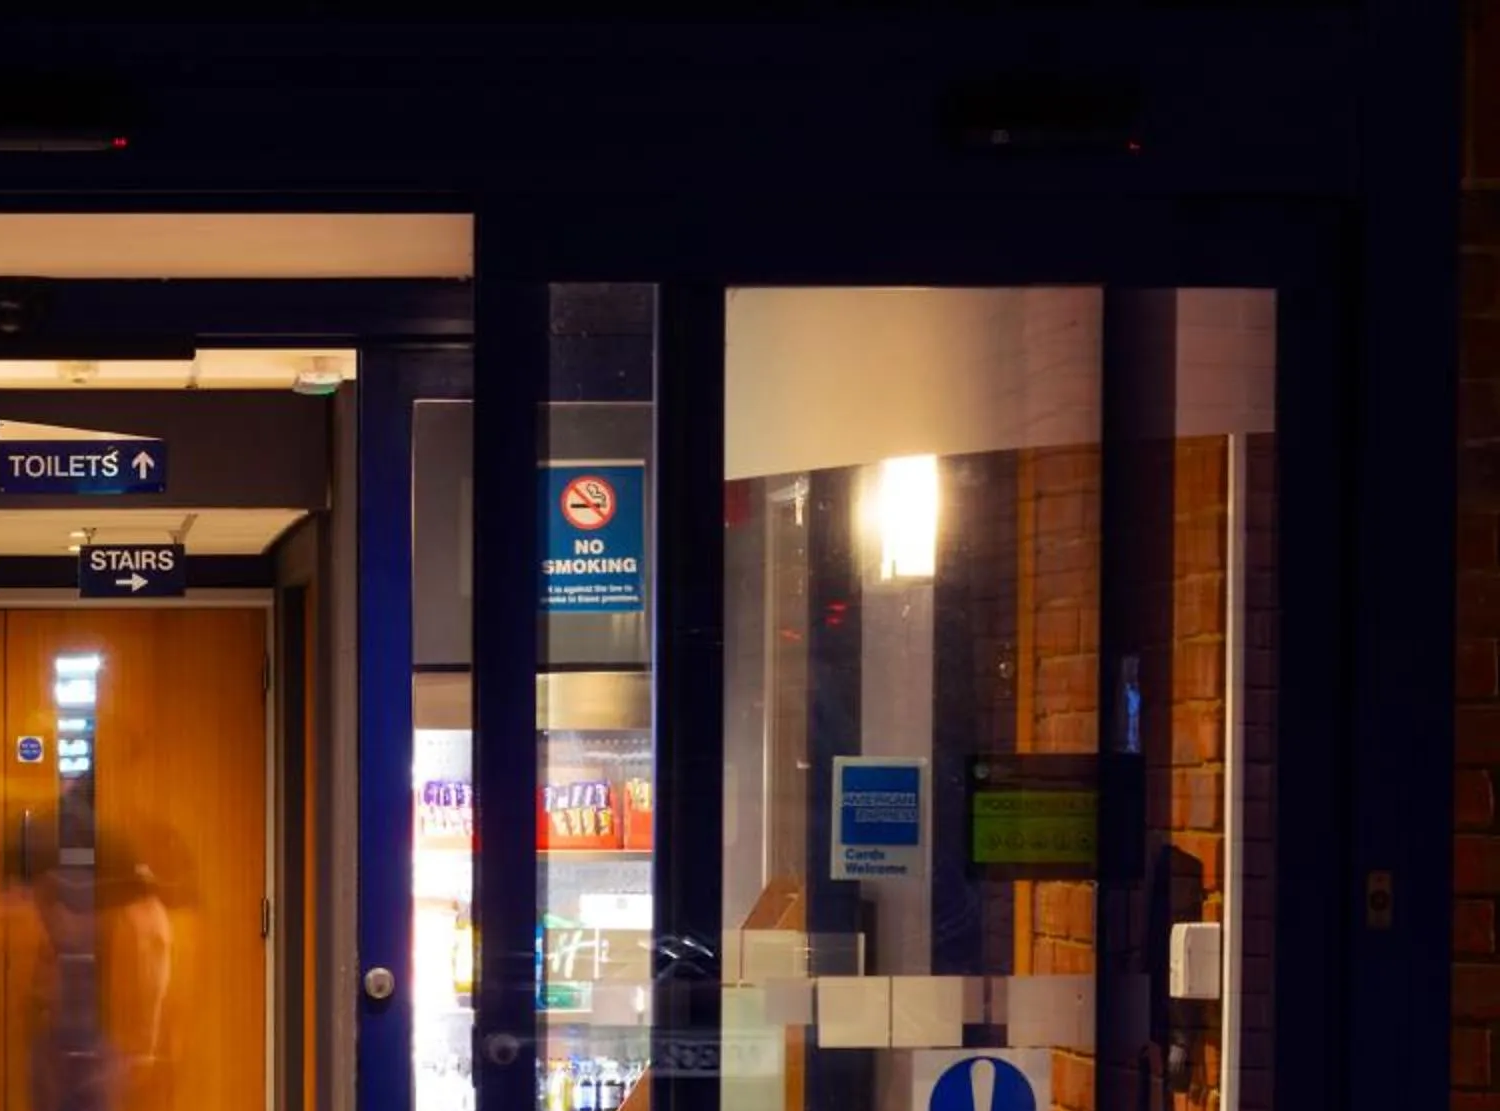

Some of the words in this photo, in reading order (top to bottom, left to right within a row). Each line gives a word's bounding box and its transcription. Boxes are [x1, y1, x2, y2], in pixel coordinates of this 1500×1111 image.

[8, 454, 119, 478] TOILETS
[574, 539, 604, 555] NO
[90, 550, 174, 571] STAIRS
[542, 558, 637, 574] SMOKING
[845, 848, 885, 860] Cards
[845, 862, 908, 875] Welcome
